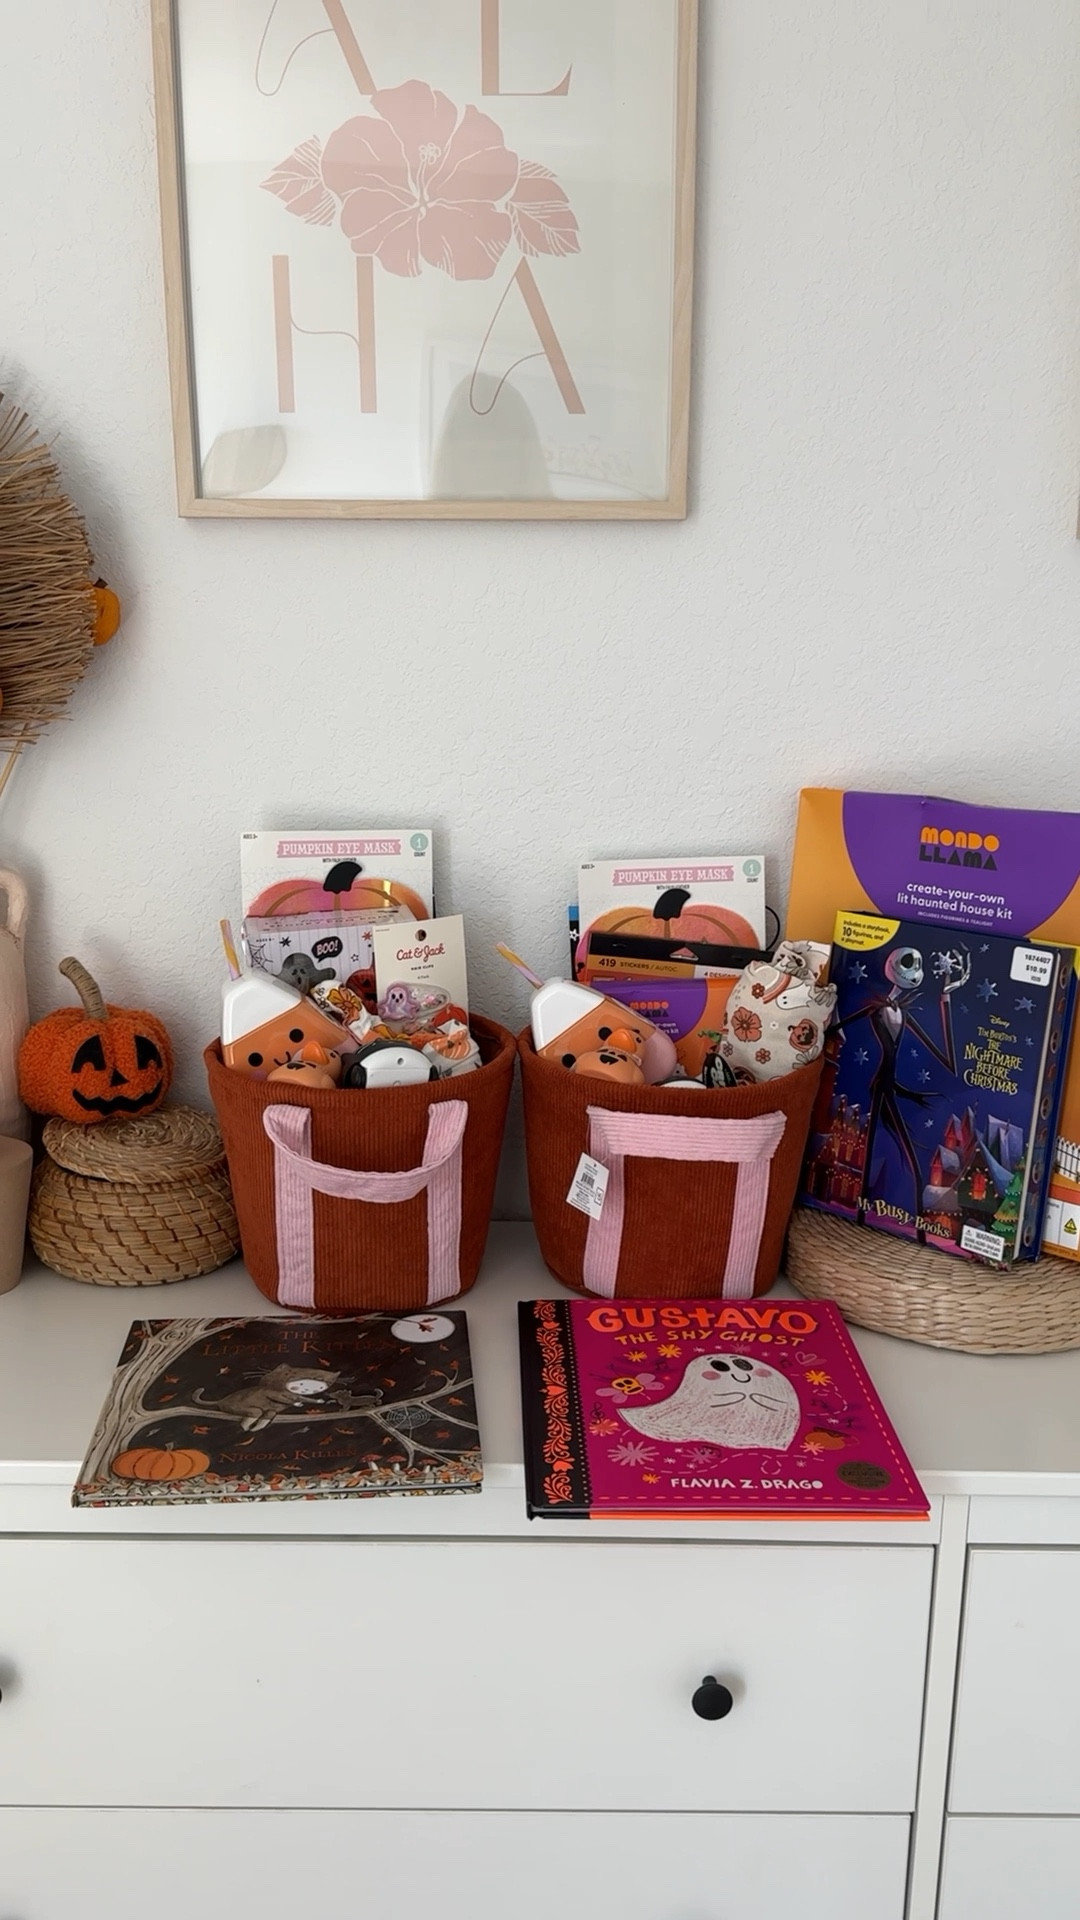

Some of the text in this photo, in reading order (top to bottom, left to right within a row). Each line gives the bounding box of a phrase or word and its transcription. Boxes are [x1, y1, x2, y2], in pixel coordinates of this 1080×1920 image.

[282, 840, 396, 856] PUMPKIN EYE MASK
[918, 844, 998, 871] LLAMA
[618, 868, 729, 884] PUMPKIN EYE MASK
[906, 883, 1005, 905] create-your-own
[897, 892, 1013, 920] lit haunted house kit
[843, 926, 852, 937] 10
[316, 940, 338, 956] BOO!
[396, 943, 446, 962] Cat & Jack
[599, 958, 617, 968] 419
[620, 961, 650, 970] STICKERS
[1026, 964, 1048, 975] $10.99
[989, 1014, 1011, 1029] Disney
[986, 1039, 1002, 1052] THE
[963, 1042, 1025, 1072] NIGHTMARE
[976, 1061, 1012, 1081] BEFORE
[963, 1068, 1019, 1096] CHRISTMAS
[857, 1196, 951, 1238] My Busy Books
[587, 1307, 818, 1335] GUSTAVO
[279, 1331, 320, 1341] THE
[614, 1330, 805, 1347] THE SHY GHOST
[203, 1340, 398, 1356] LITTLE KITTEN
[219, 1449, 357, 1464] NICOLA KILLEN
[670, 1478, 823, 1490] FLAVIA Z. DRAGO
